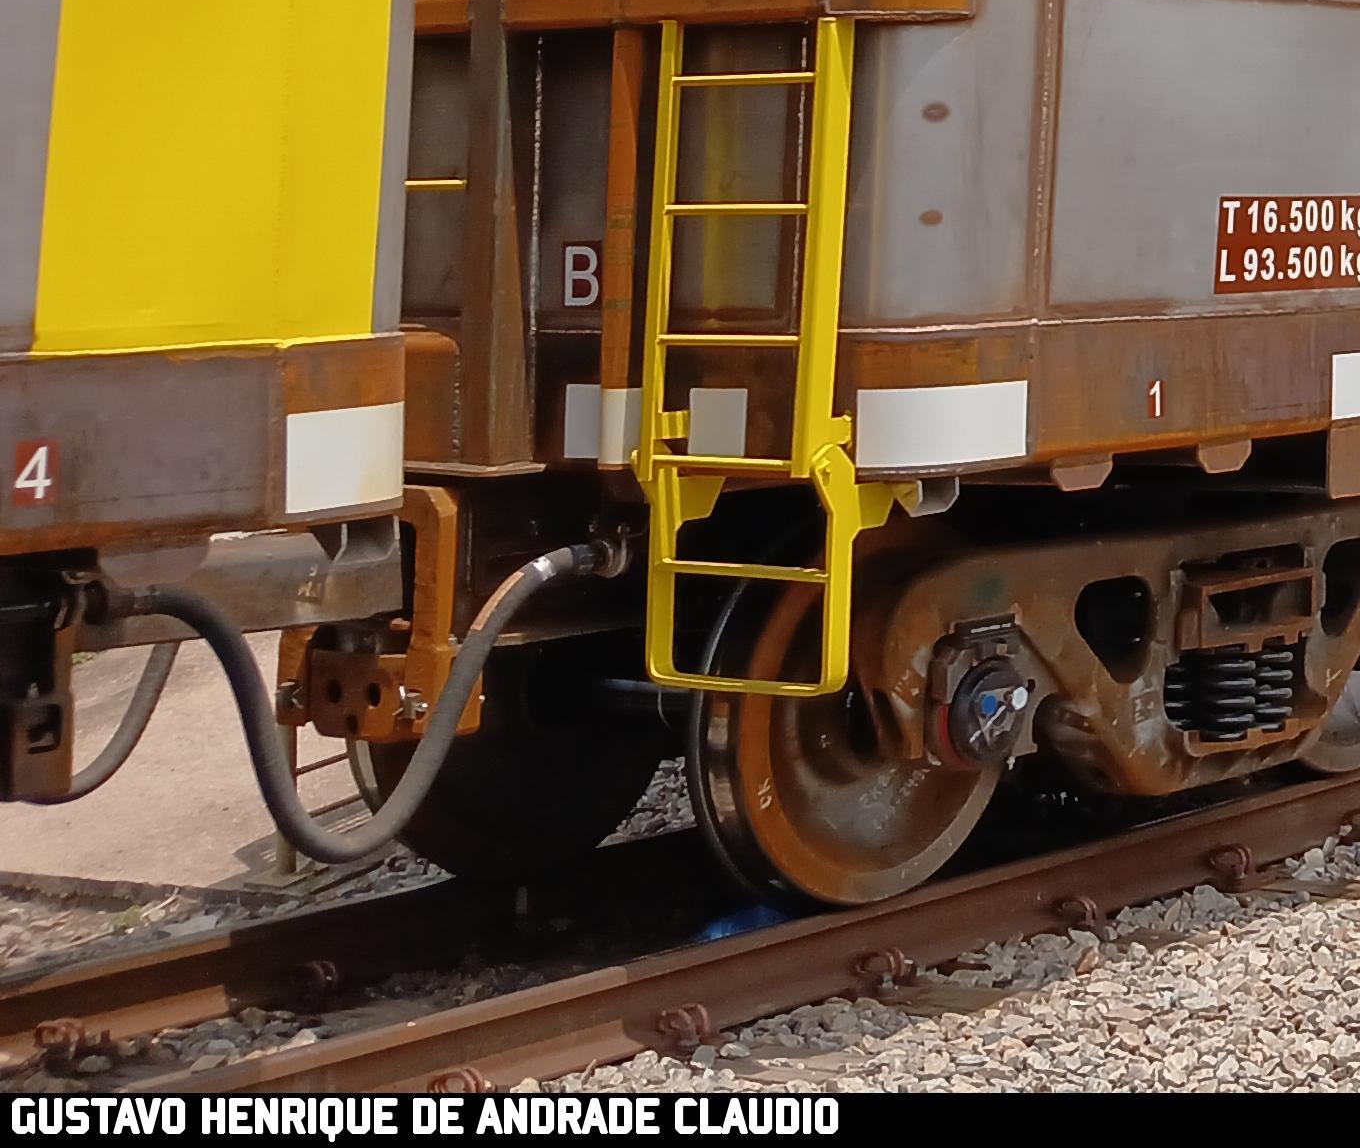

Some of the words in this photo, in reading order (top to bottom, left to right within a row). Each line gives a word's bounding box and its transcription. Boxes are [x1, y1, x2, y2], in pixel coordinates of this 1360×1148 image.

[1222, 200, 1241, 234] T
[1247, 199, 1334, 234] 16.500
[564, 245, 600, 307] B
[1219, 249, 1236, 282] L
[1243, 245, 1334, 282] 93.500
[1149, 380, 1161, 417] 1
[14, 446, 52, 499] 4
